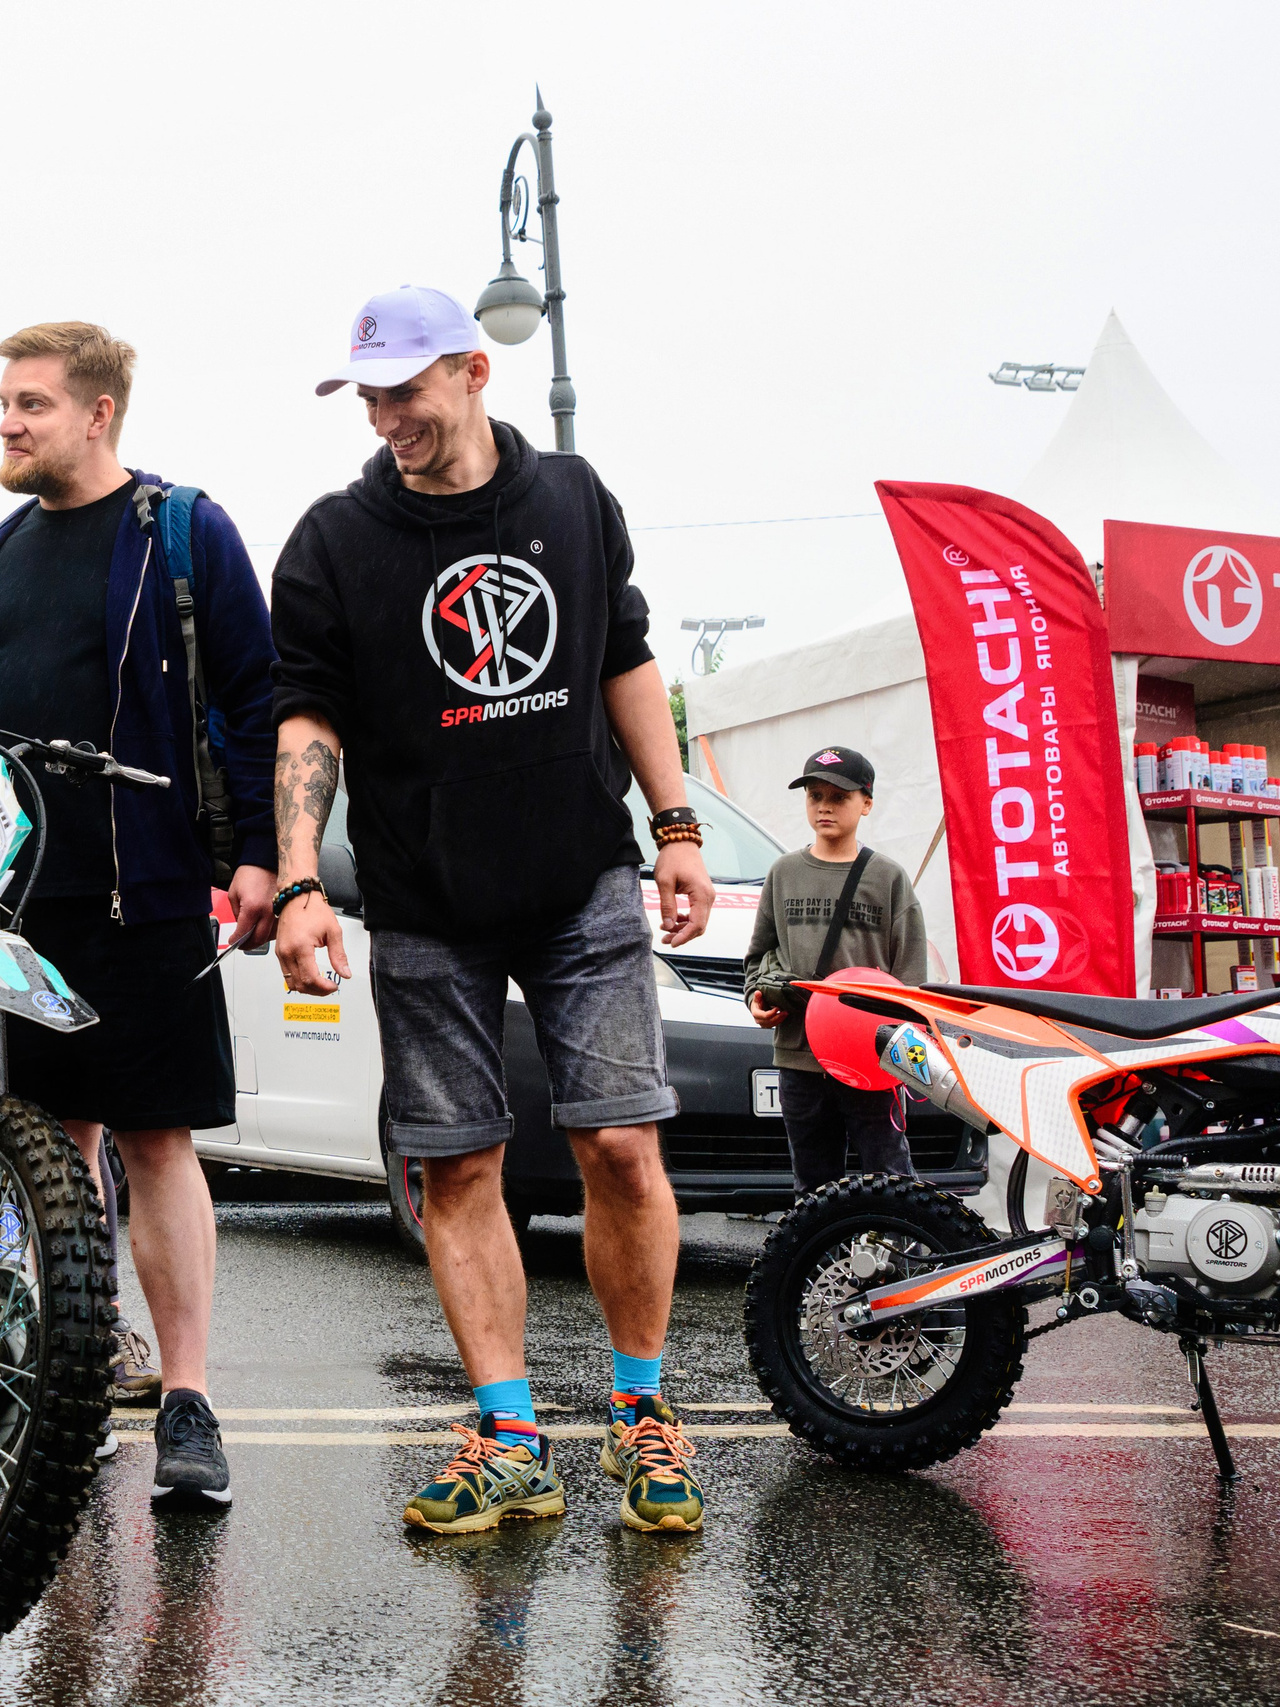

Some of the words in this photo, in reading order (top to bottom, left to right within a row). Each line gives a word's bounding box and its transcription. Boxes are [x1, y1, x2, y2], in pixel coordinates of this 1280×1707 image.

[1009, 565, 1053, 669] ЯПОНИЯ
[440, 688, 569, 727] SPRMOTORS
[959, 569, 1040, 897] TOTACHI
[1040, 686, 1070, 876] АВТОТОВАРЫ
[1152, 796, 1181, 804] TOTACHI
[1200, 795, 1223, 804] TOTACHI
[806, 898, 821, 906] DAY
[824, 898, 831, 906] IS
[806, 907, 821, 915] DAY
[823, 908, 831, 916] IS
[284, 1031, 340, 1041] www.mcmauto.ru
[765, 1086, 778, 1107] T
[959, 1247, 1042, 1293] SPRMOTORS
[1205, 1259, 1248, 1267] SPRMOTORS
